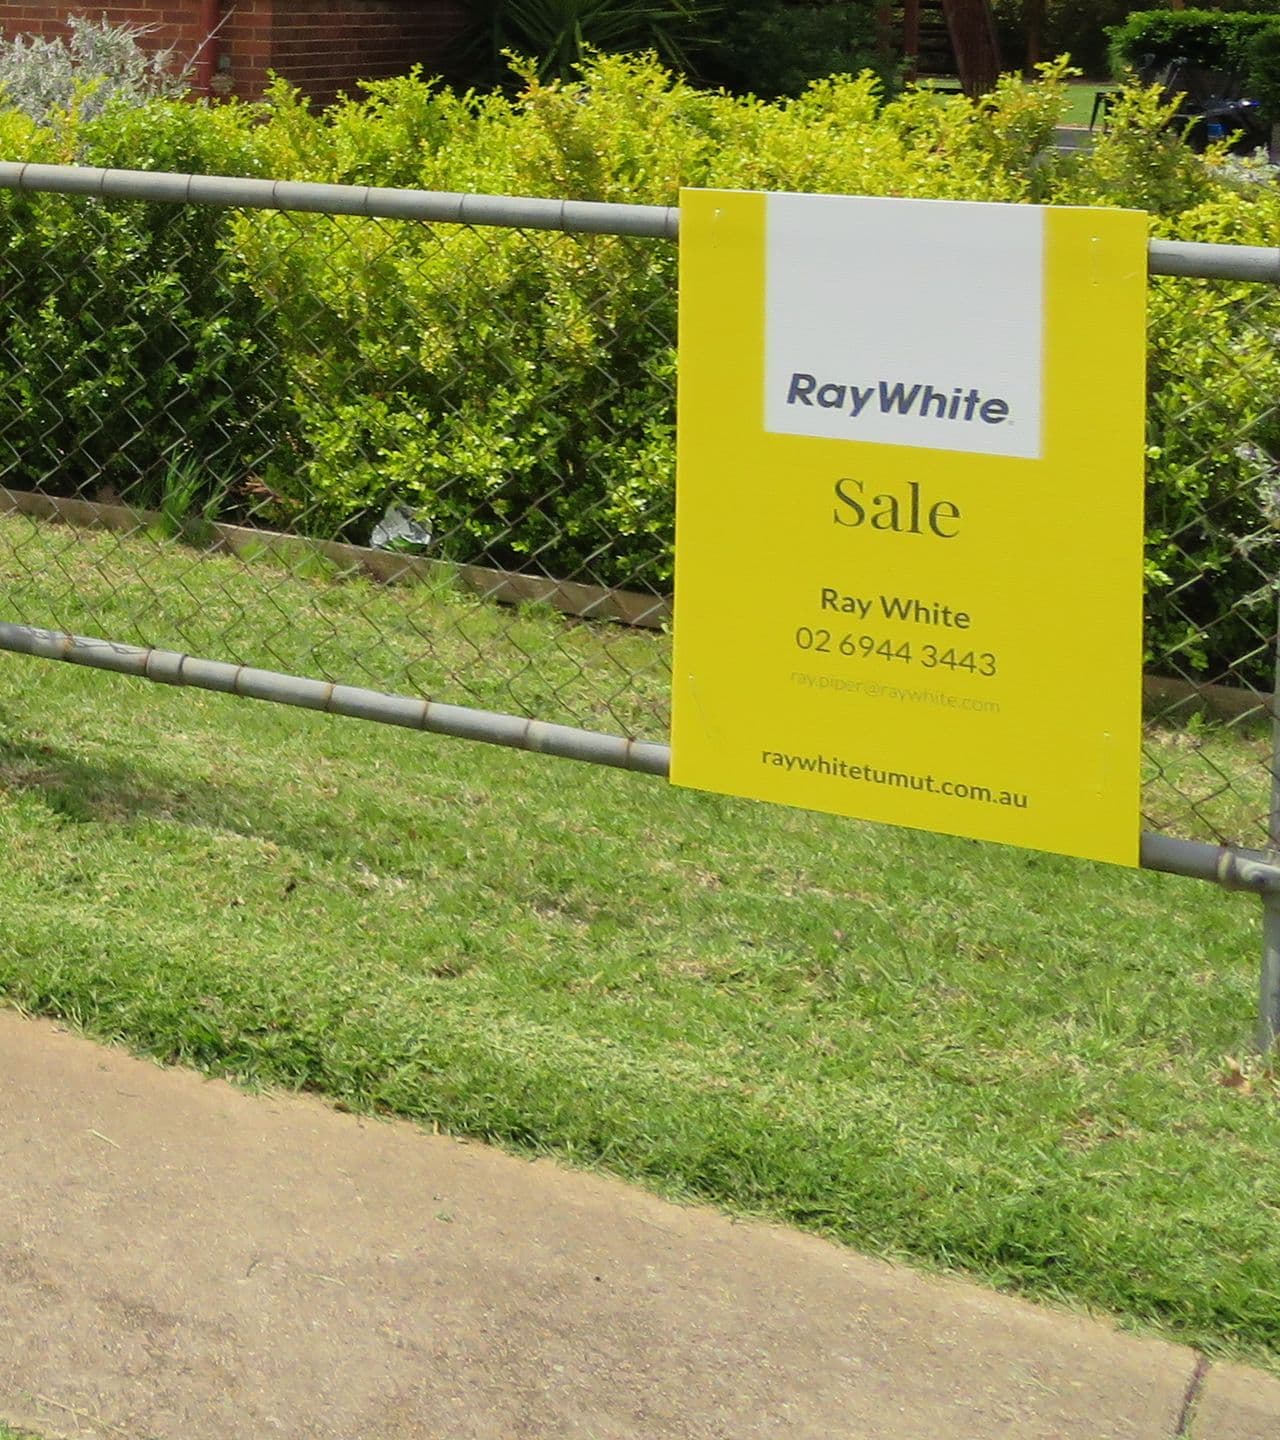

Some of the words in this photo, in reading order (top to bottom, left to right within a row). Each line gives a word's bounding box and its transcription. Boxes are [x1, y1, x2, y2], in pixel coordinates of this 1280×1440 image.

[833, 477, 962, 539] Sale
[821, 588, 872, 620] Ray
[879, 596, 971, 630] White
[795, 626, 831, 653] 02
[839, 633, 912, 664] 6944
[920, 644, 997, 677] 3443
[761, 749, 1028, 809] raywhitetumut.com.au
